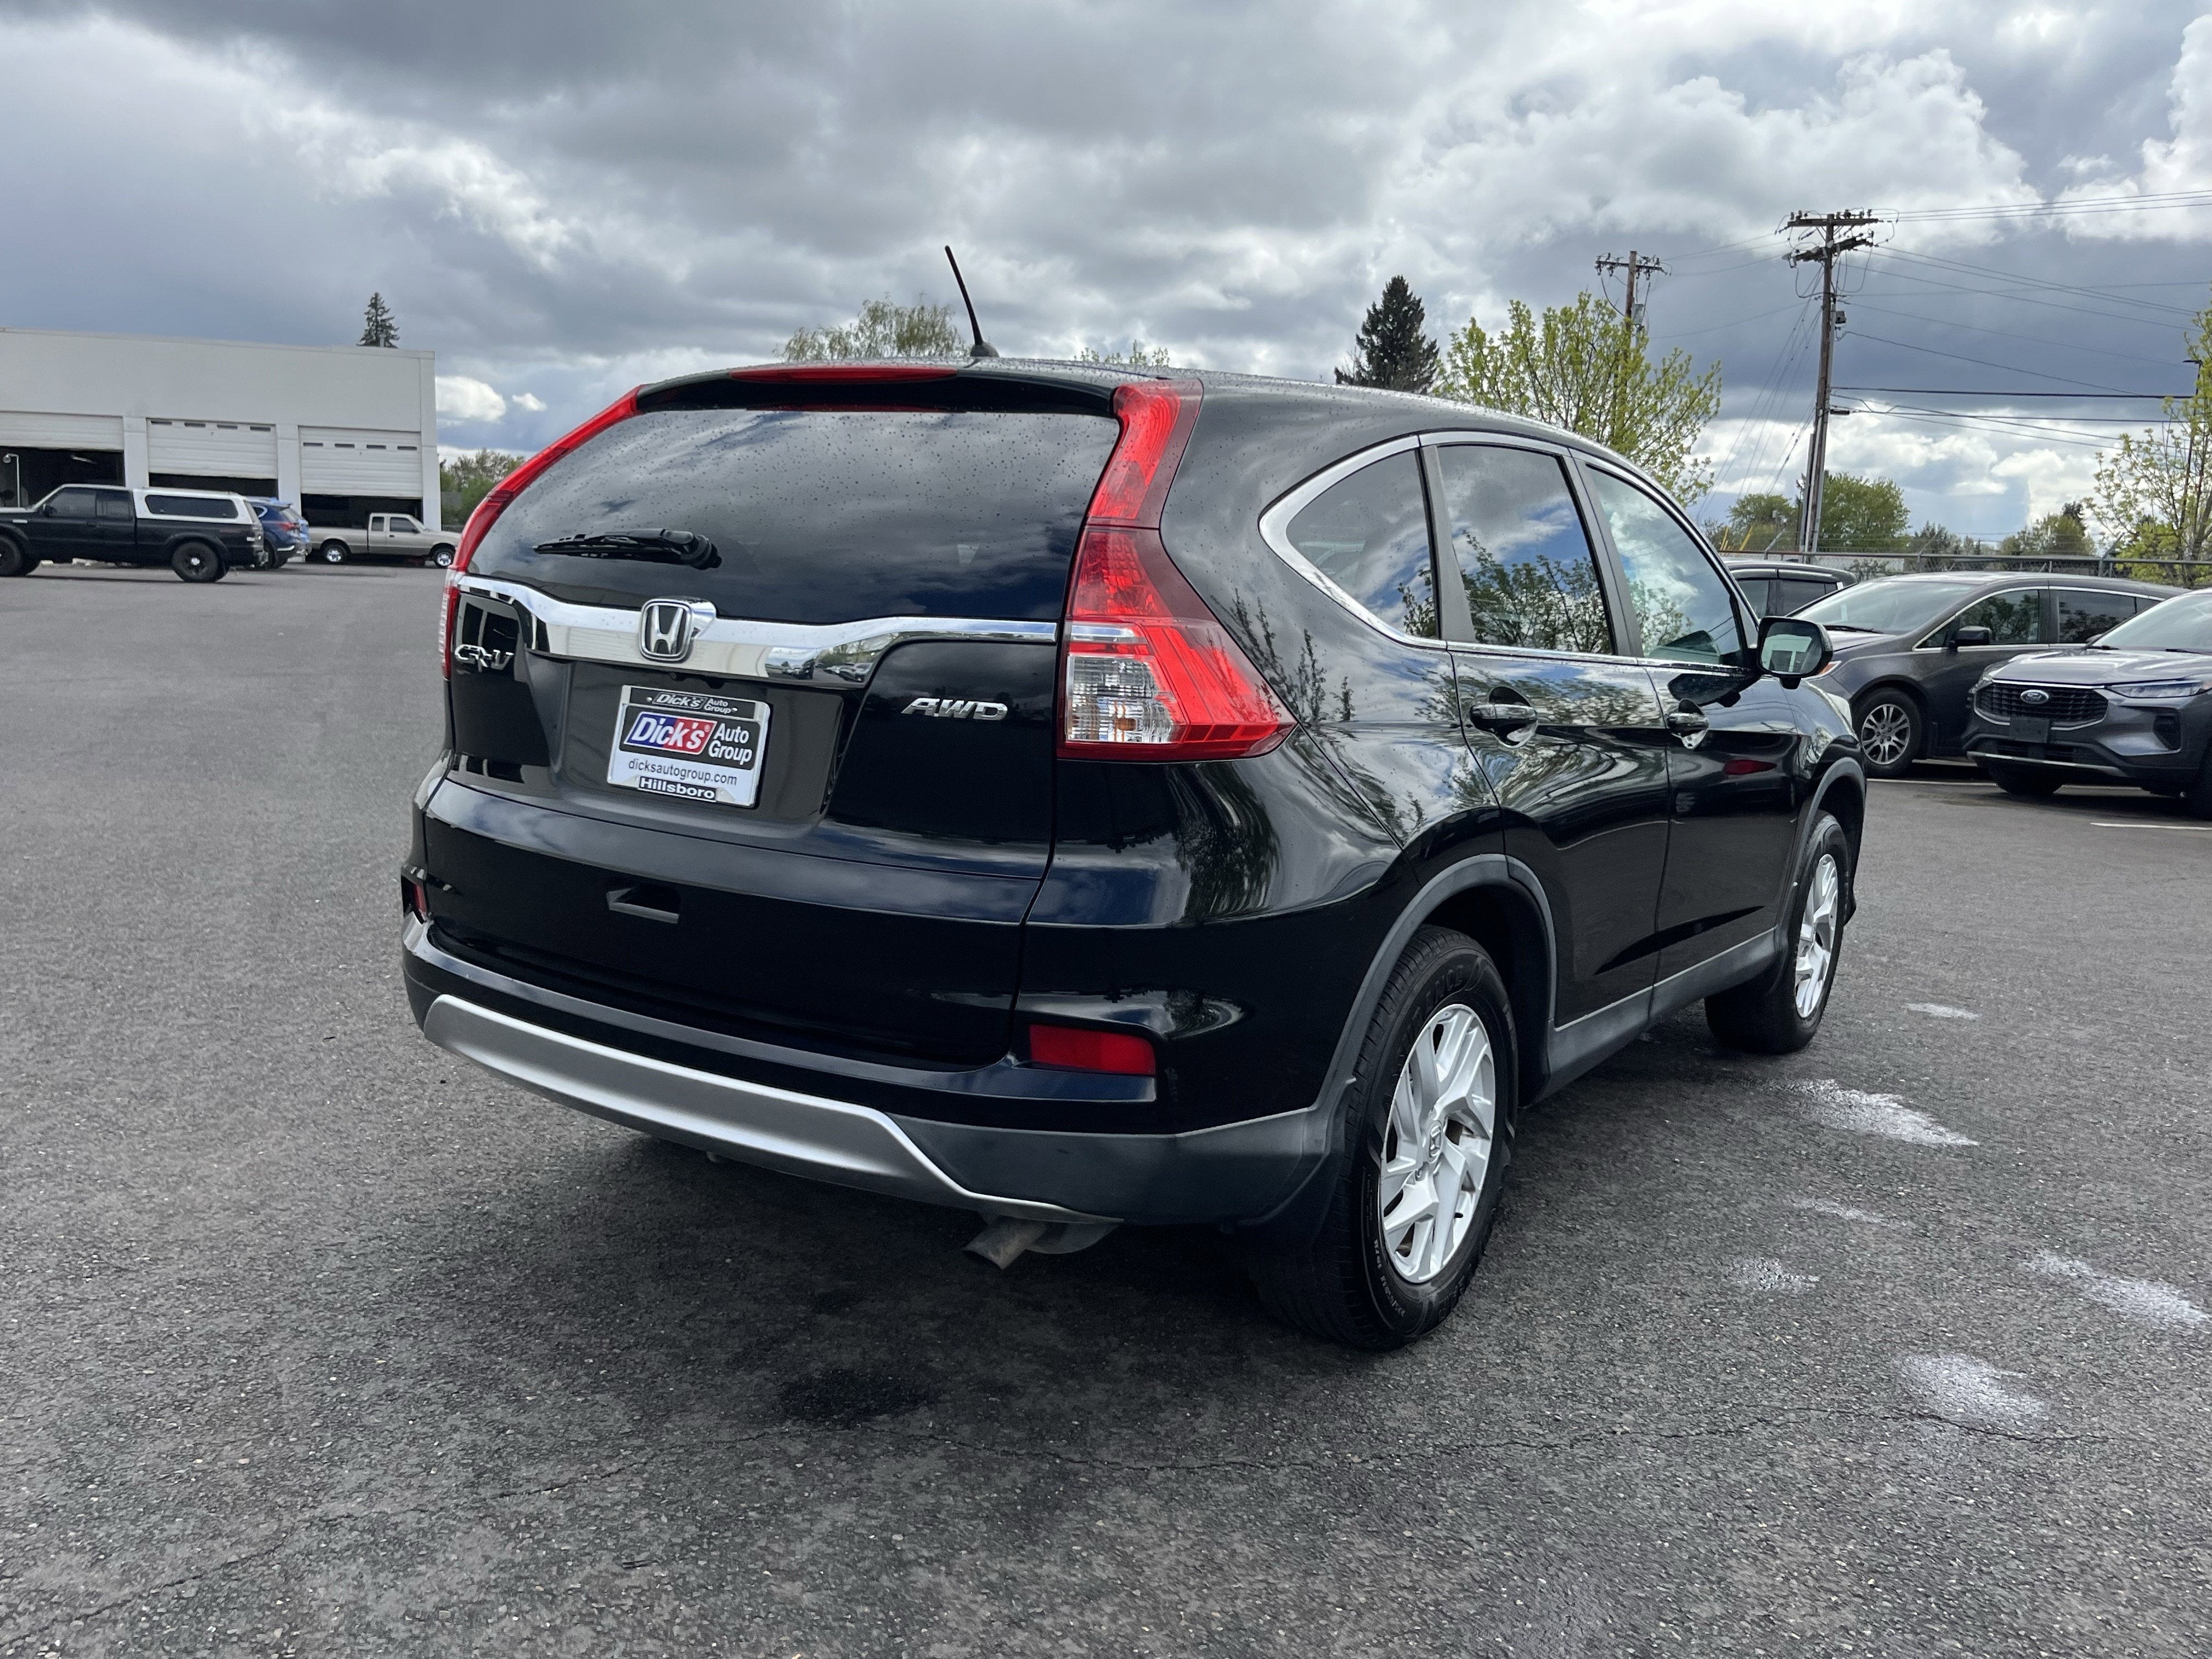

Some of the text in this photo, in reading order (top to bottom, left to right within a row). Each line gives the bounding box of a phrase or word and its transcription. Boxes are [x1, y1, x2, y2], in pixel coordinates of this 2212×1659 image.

[656, 693, 702, 708] Dick's
[704, 703, 731, 714] Group
[708, 698, 729, 707] Auto
[901, 697, 1008, 720] AWD
[631, 716, 705, 749] Dick's
[713, 723, 749, 744] Auto
[708, 740, 753, 765] Group
[628, 758, 737, 786] dicksautogroup.com
[639, 777, 715, 799] Hillsboro
